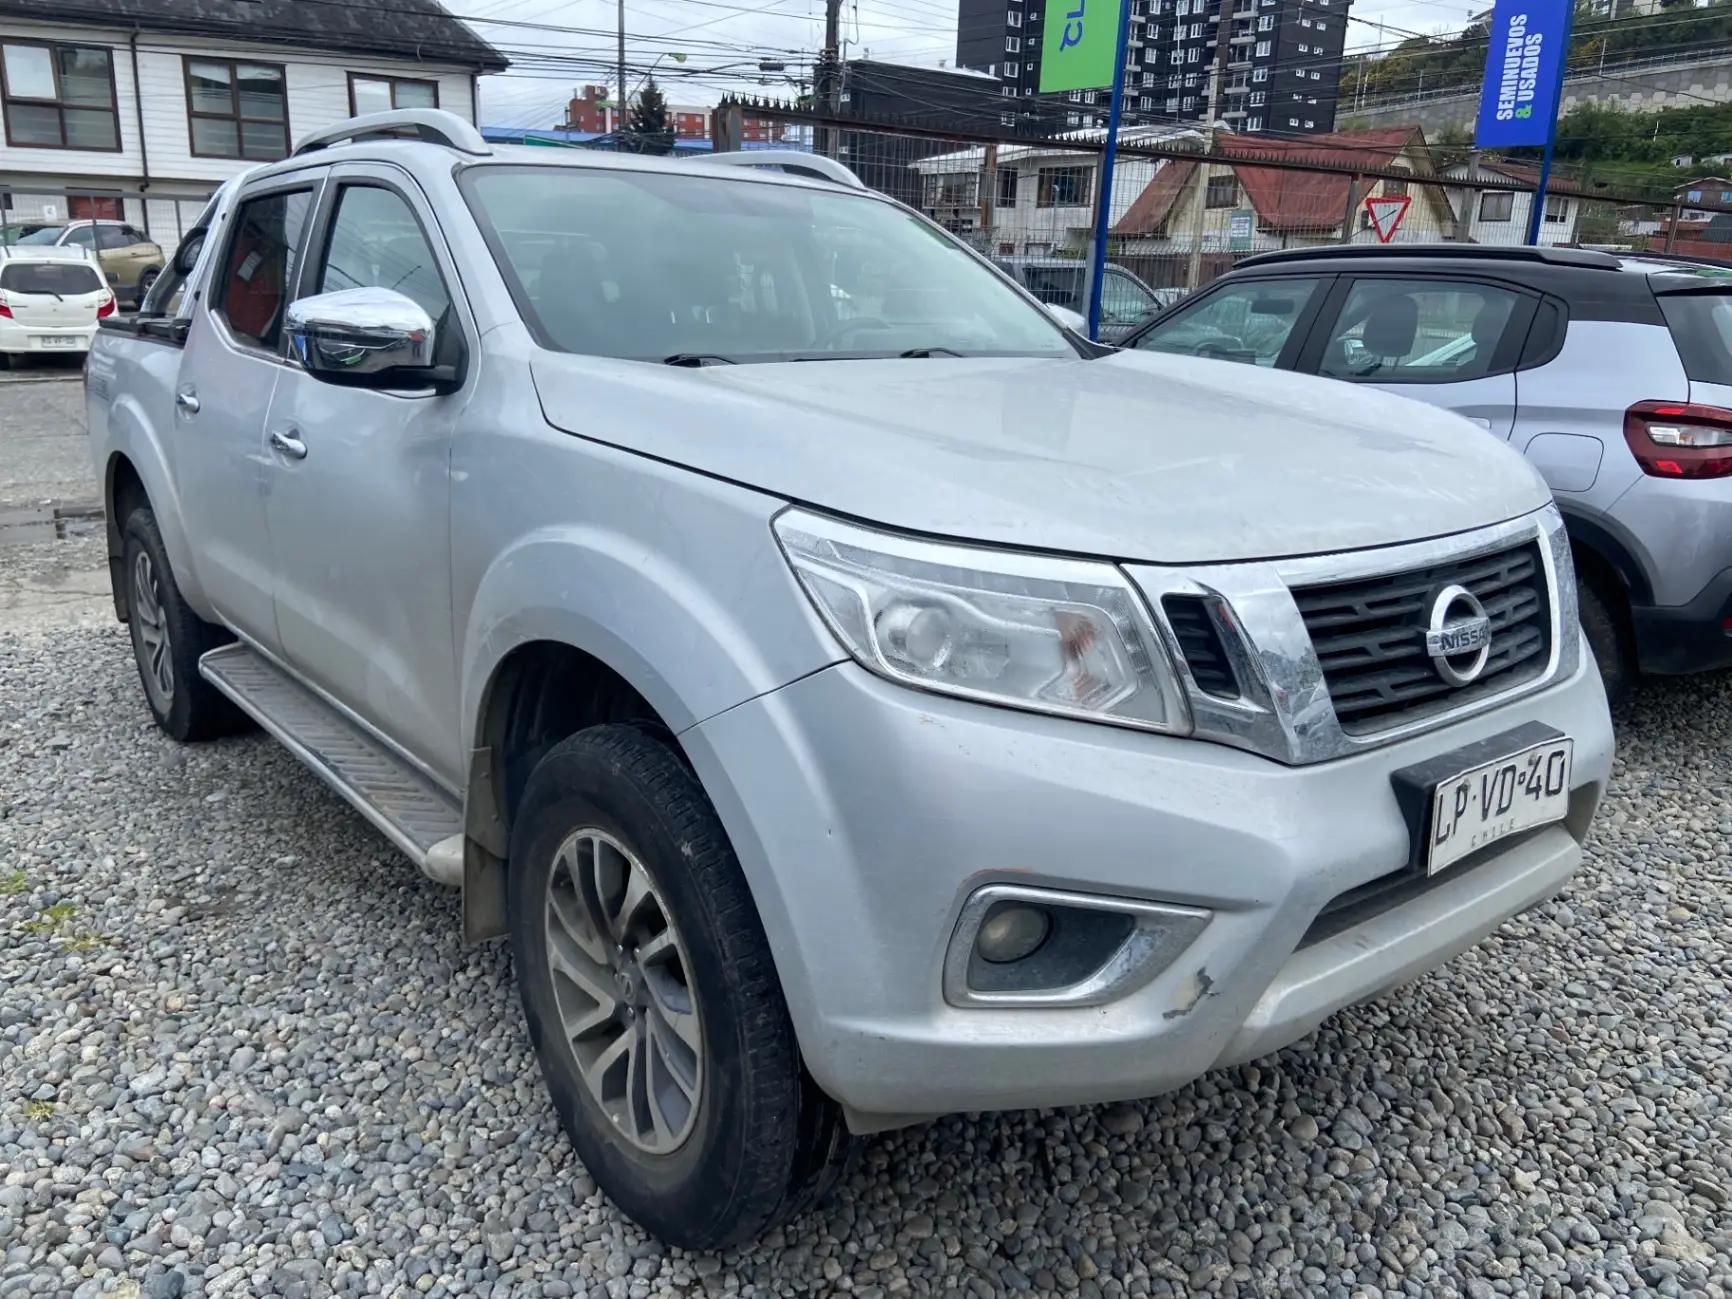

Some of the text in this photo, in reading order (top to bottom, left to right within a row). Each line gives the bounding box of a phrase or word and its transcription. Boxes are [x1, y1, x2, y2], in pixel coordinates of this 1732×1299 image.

[1496, 14, 1527, 120] SEMINUEVOS
[1514, 33, 1543, 118] & USADOS
[1439, 624, 1489, 651] NISSA
[1471, 818, 1515, 848] CHILE
